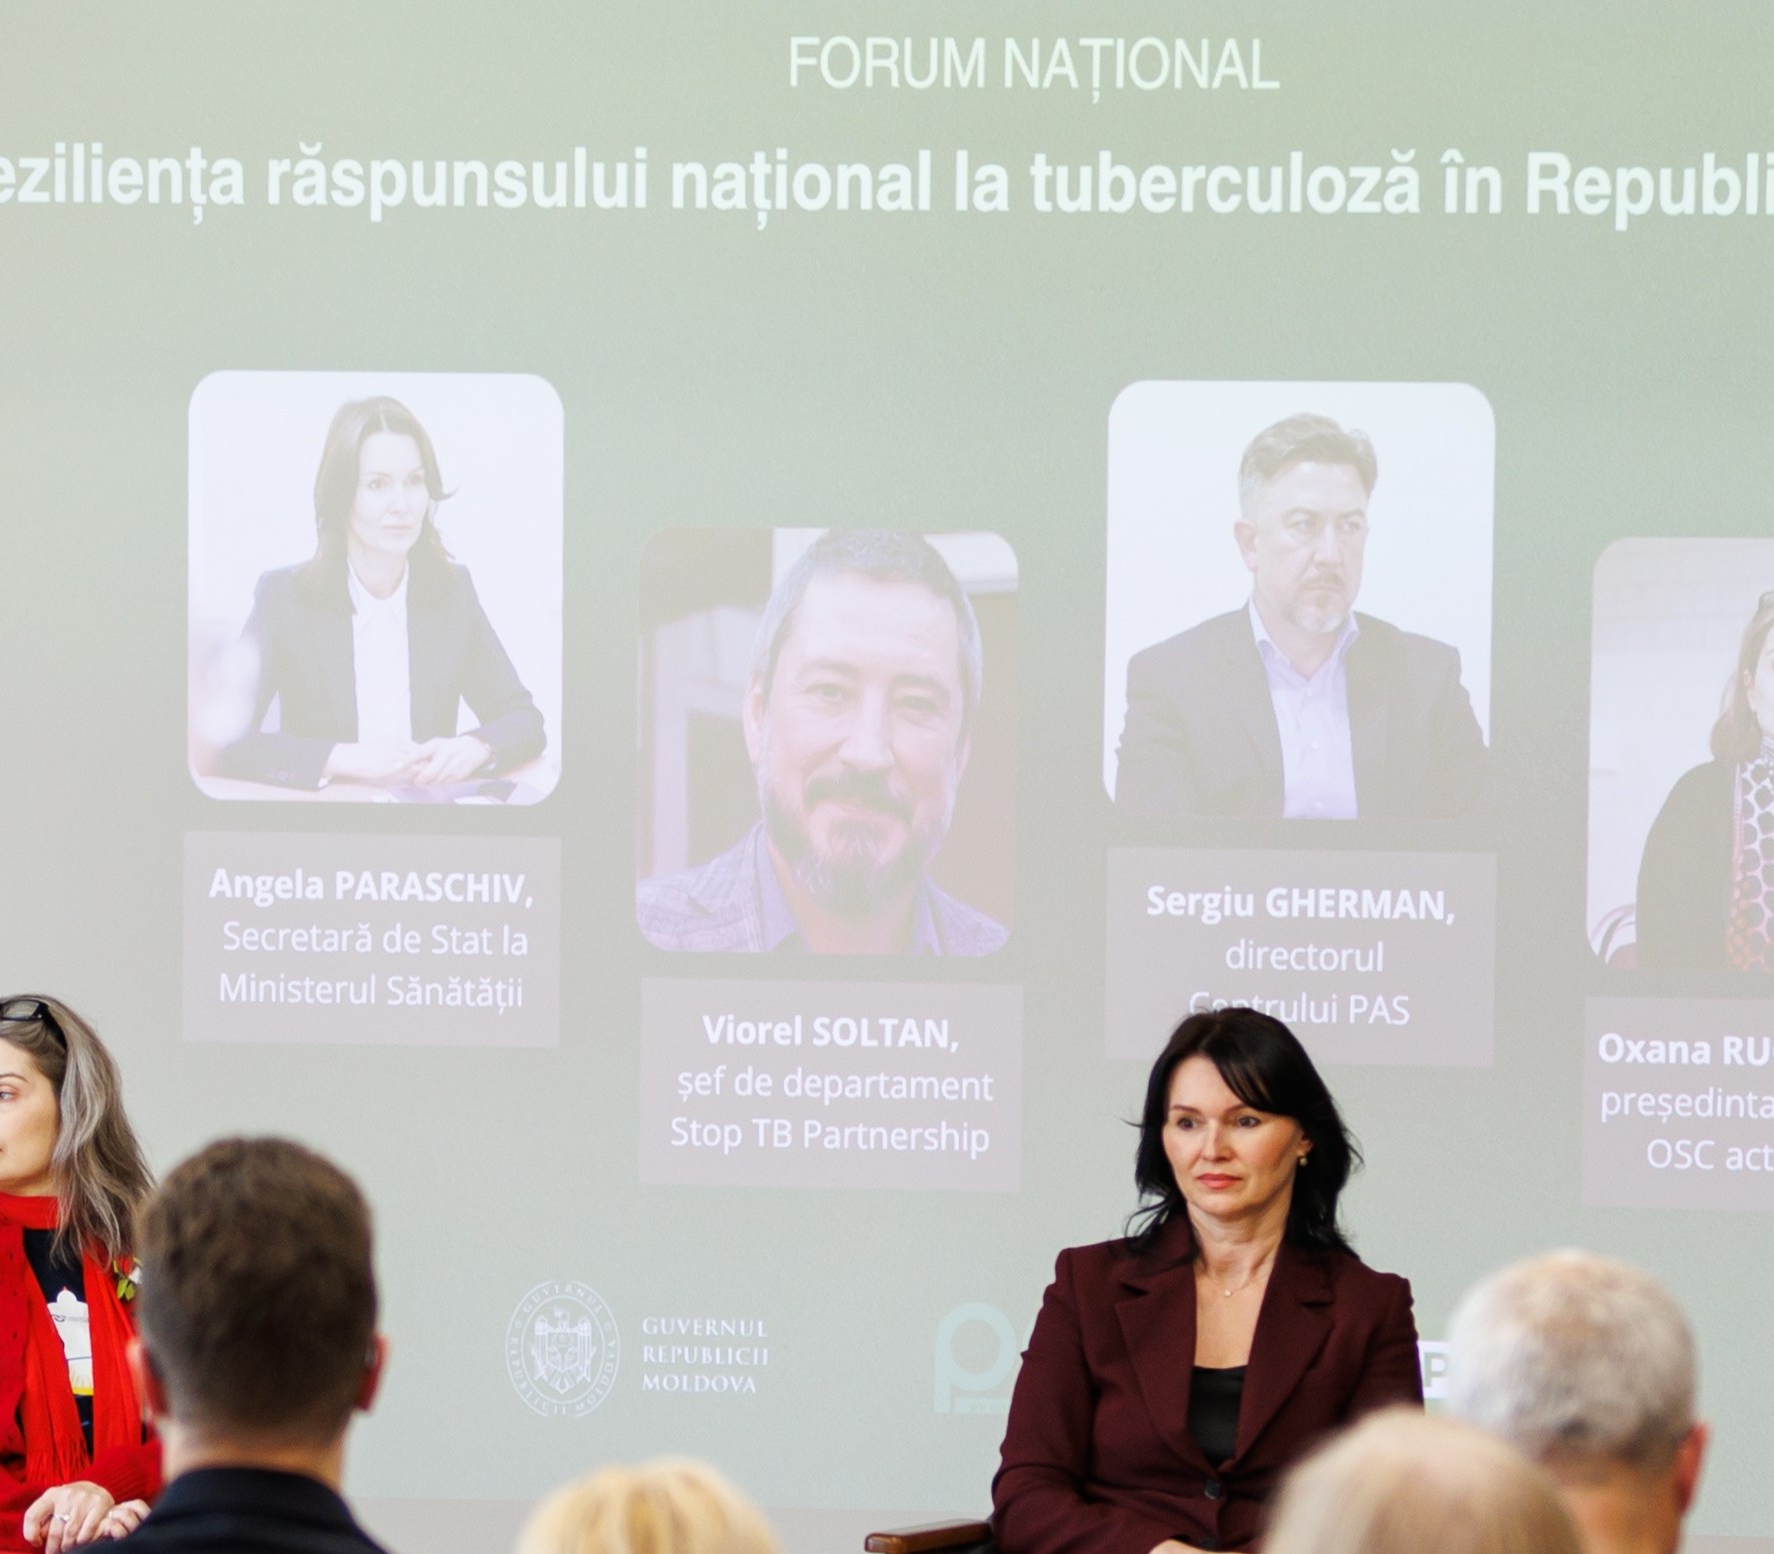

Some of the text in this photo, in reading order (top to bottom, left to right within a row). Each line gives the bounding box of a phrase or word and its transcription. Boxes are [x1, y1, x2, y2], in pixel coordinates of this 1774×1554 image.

[788, 36, 1281, 104] FORUM NAȚIONAL
[267, 140, 649, 223] răspunsului
[671, 148, 931, 231] național
[955, 149, 1010, 212] la
[1030, 148, 1421, 214] tuberculoză
[1439, 148, 1503, 215] în
[208, 867, 533, 909] Angela PARASCHIV,
[1146, 884, 1456, 926] Sergiu GHERMAN,
[222, 921, 529, 956] Secretară de Stat la
[1224, 938, 1385, 973] directorul
[219, 973, 523, 1015] Ministerul Sănătății
[1348, 994, 1411, 1026] PAS
[701, 1014, 960, 1054] Viorel SOLTAN,
[1597, 1033, 1711, 1065] Oxana
[677, 1064, 994, 1106] șef de departament
[670, 1117, 991, 1160] Stop TB Partnership
[1646, 1138, 1716, 1170] OSC
[641, 1316, 768, 1339] GUVERNUL
[641, 1345, 770, 1367] REPUBLICII
[641, 1374, 758, 1394] MOLDOVA
